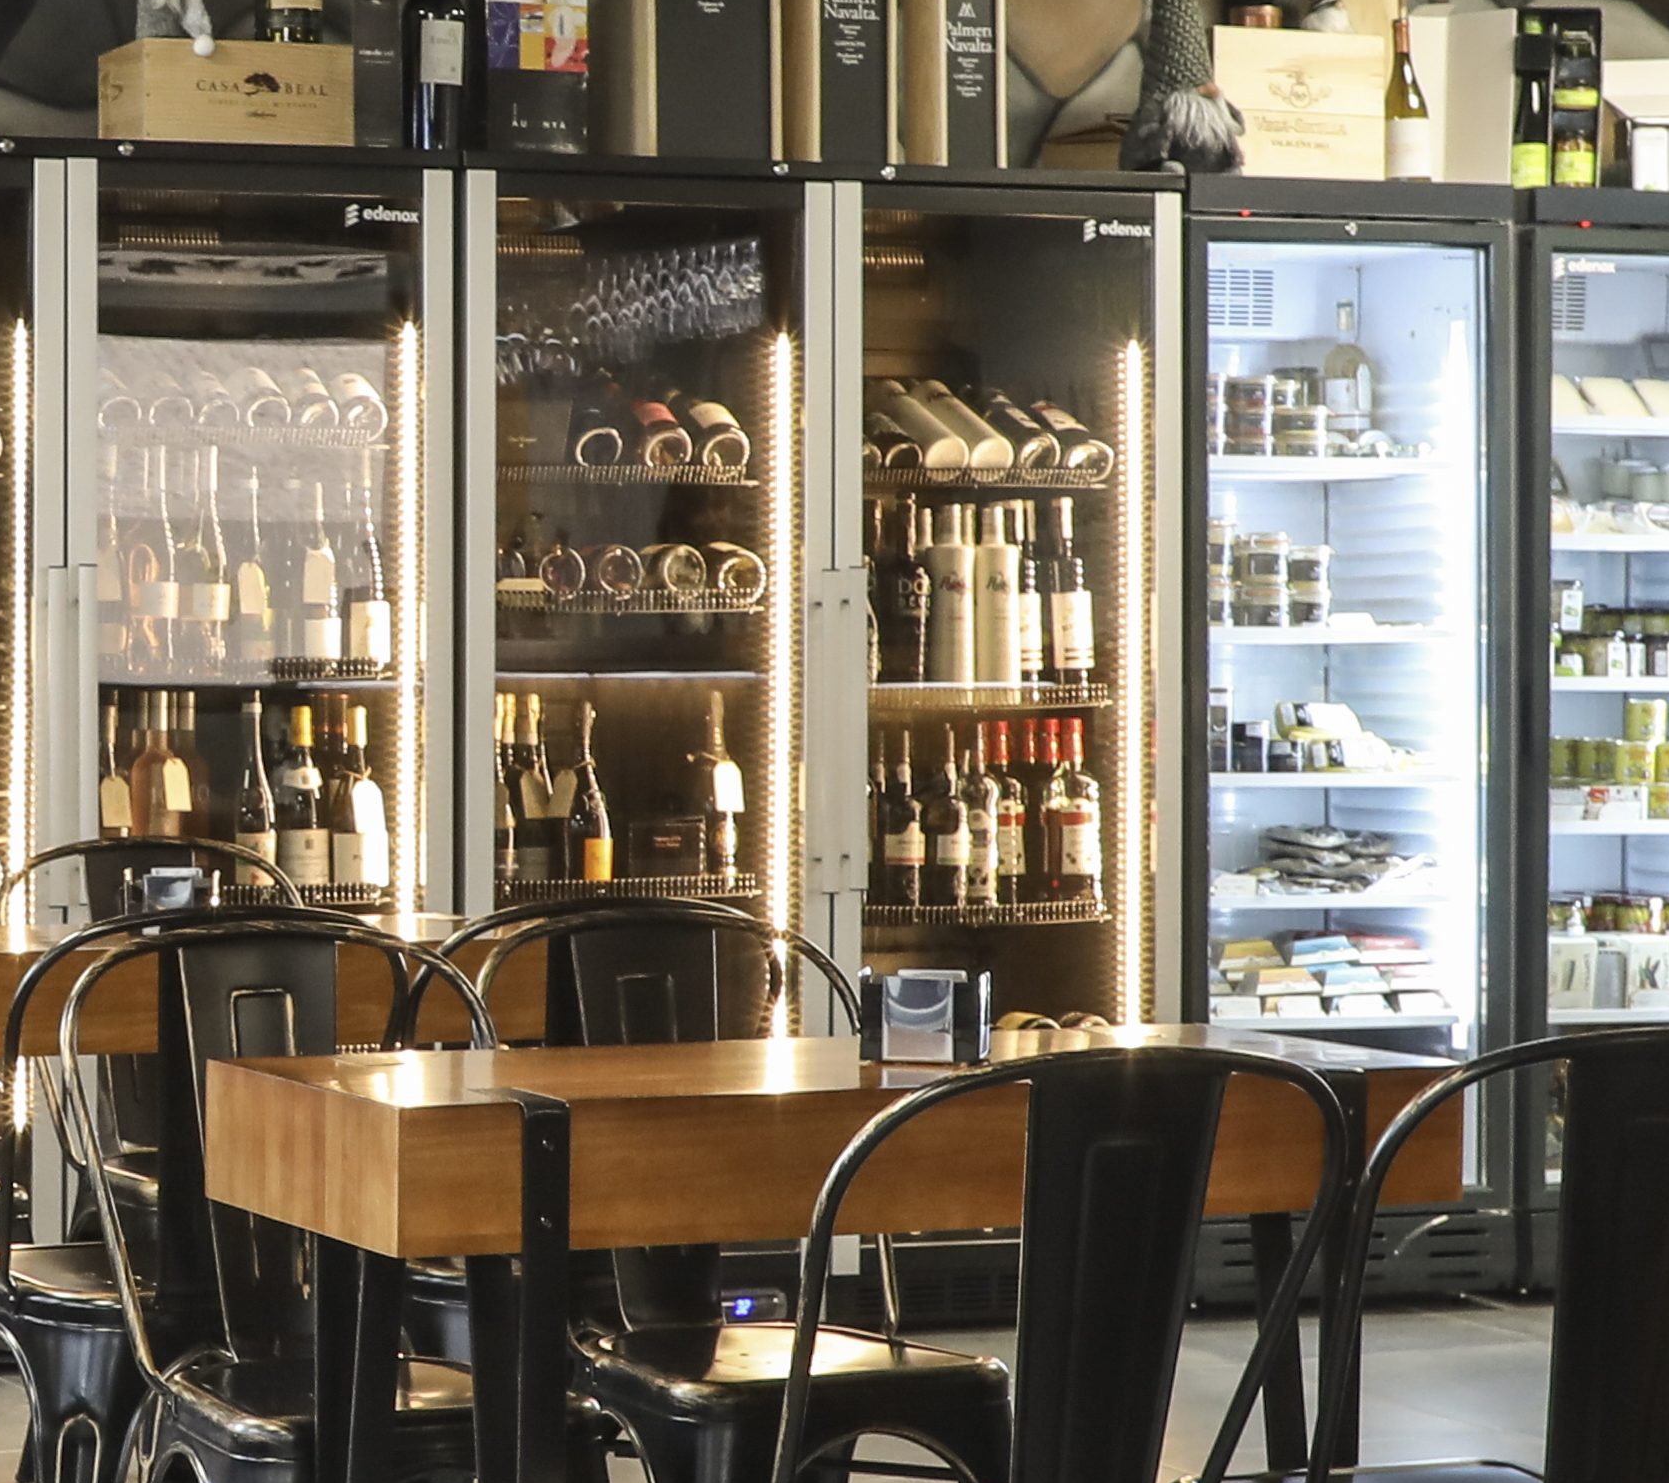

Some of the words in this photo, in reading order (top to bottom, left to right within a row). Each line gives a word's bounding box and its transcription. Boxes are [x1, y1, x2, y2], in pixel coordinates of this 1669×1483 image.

[196, 79, 240, 93] CASA
[284, 83, 328, 96] BEAL
[362, 204, 420, 224] edenox
[1098, 219, 1152, 238] edenox
